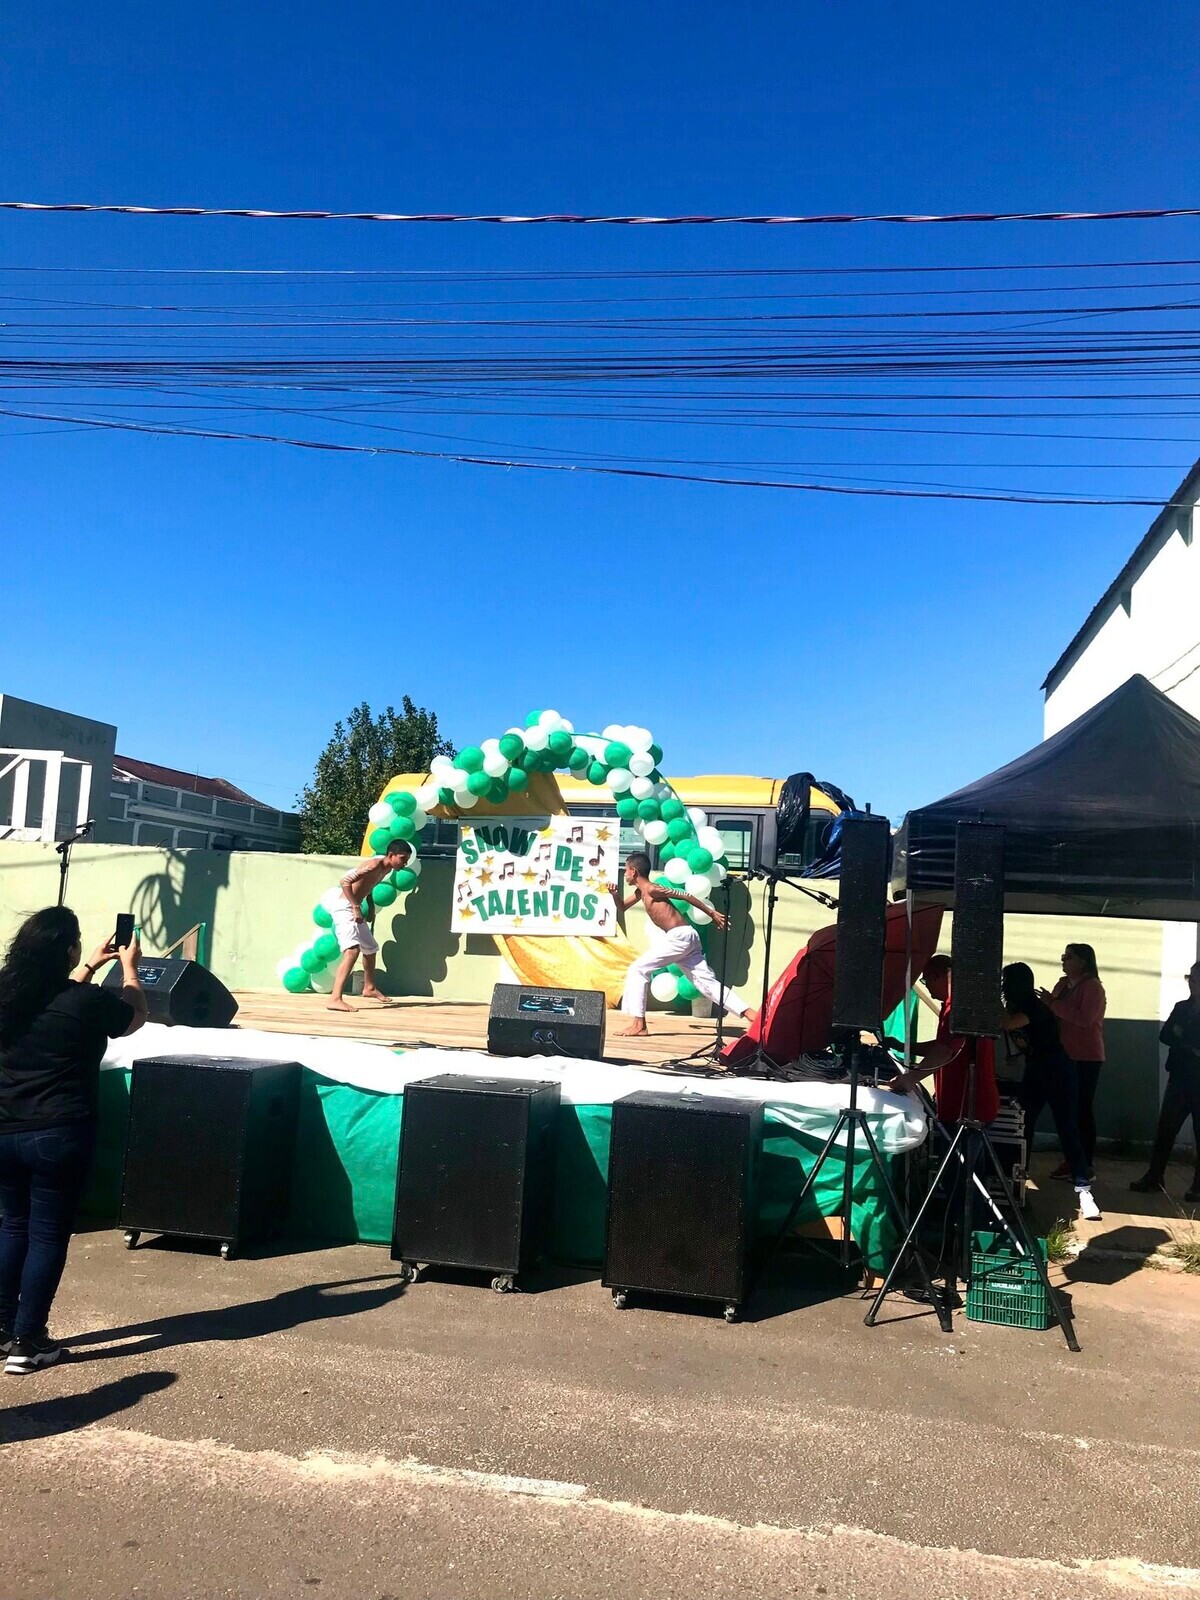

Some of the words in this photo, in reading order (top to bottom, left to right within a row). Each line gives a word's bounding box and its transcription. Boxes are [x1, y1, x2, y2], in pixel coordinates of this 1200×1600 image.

[461, 825, 537, 864] SHOW
[554, 845, 584, 882] DE
[471, 885, 598, 921] TALENTOS
